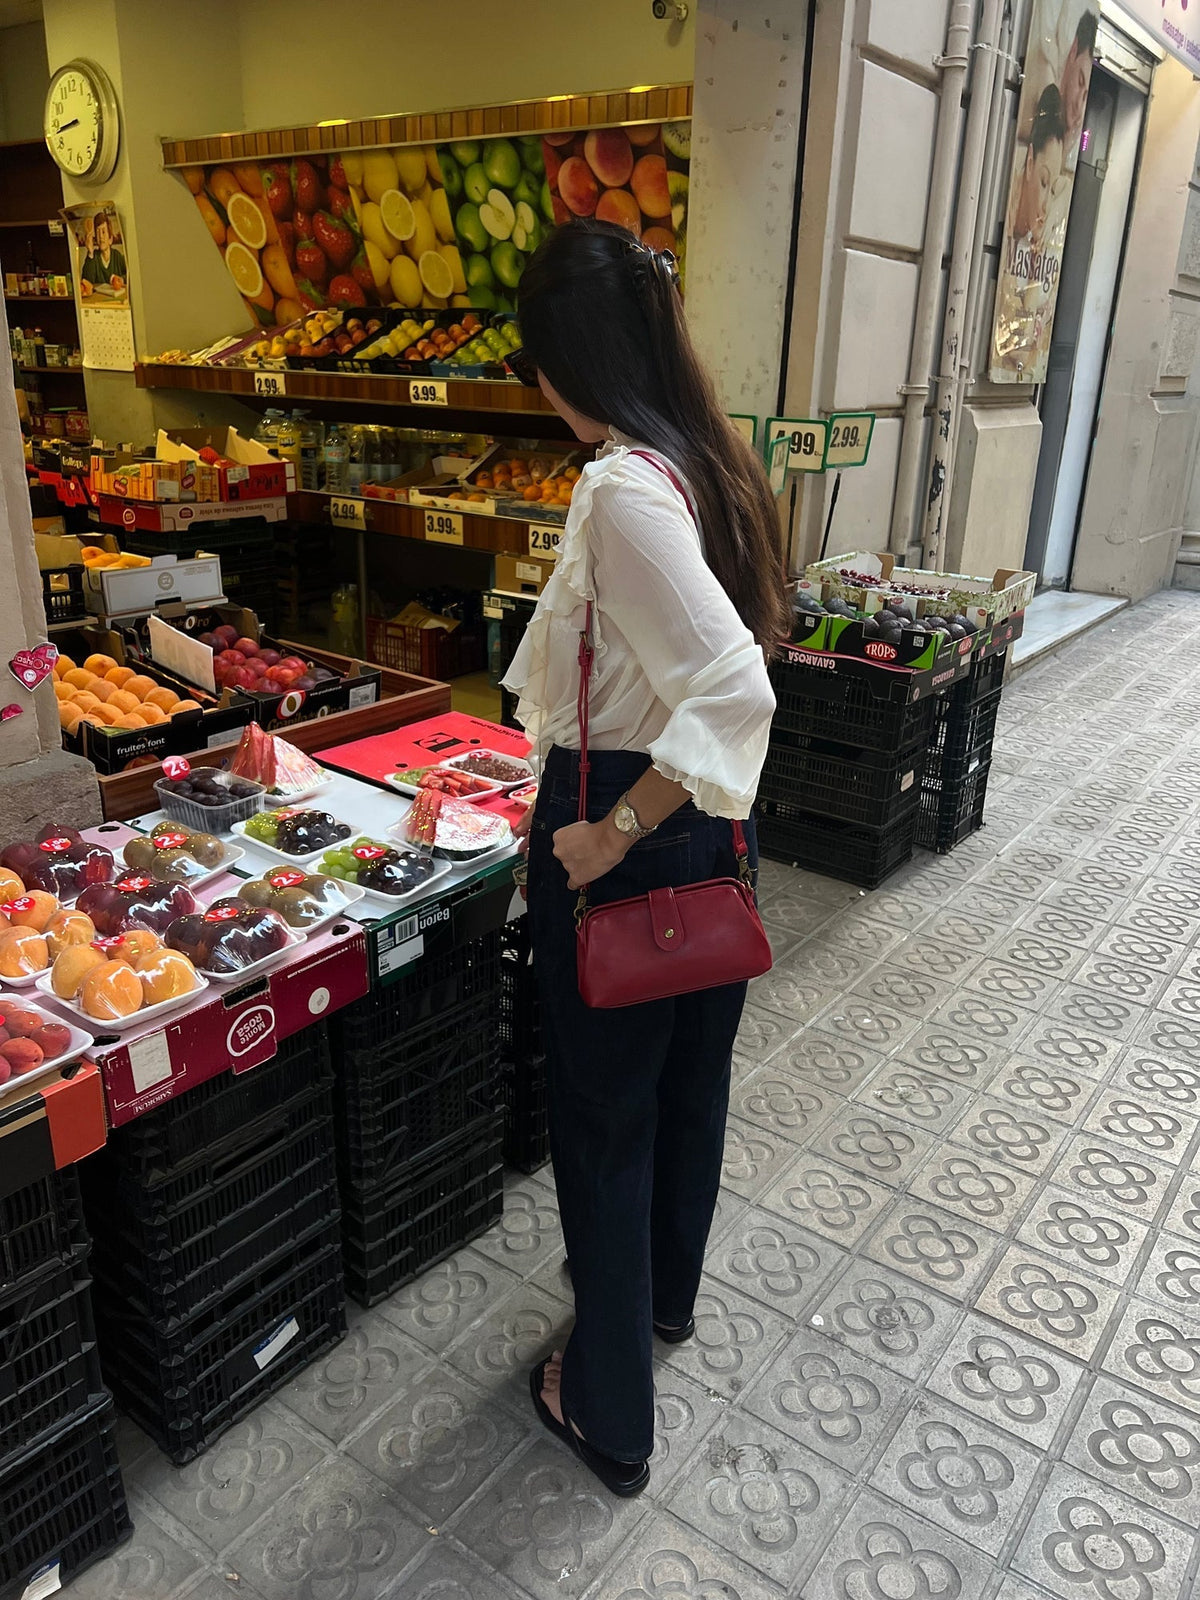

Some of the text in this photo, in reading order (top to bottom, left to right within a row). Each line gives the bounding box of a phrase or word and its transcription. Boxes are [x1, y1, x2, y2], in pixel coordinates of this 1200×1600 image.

[68, 79, 76, 92] 12
[80, 80, 84, 95] 1
[60, 87, 67, 100] 11
[87, 93, 92, 106] 2
[53, 102, 64, 115] 10
[93, 112, 98, 125] 3
[57, 136, 64, 150] 8
[91, 131, 96, 144] 4
[68, 149, 73, 161] 7
[76, 152, 83, 165] 6
[87, 146, 92, 159] 5
[865, 643, 896, 659] TROPS
[788, 650, 836, 670] GAVAROSA
[117, 738, 166, 755] fruites font
[420, 908, 450, 930] Baron
[239, 1021, 266, 1045] Monte
[134, 1088, 172, 1113] SABORUM
